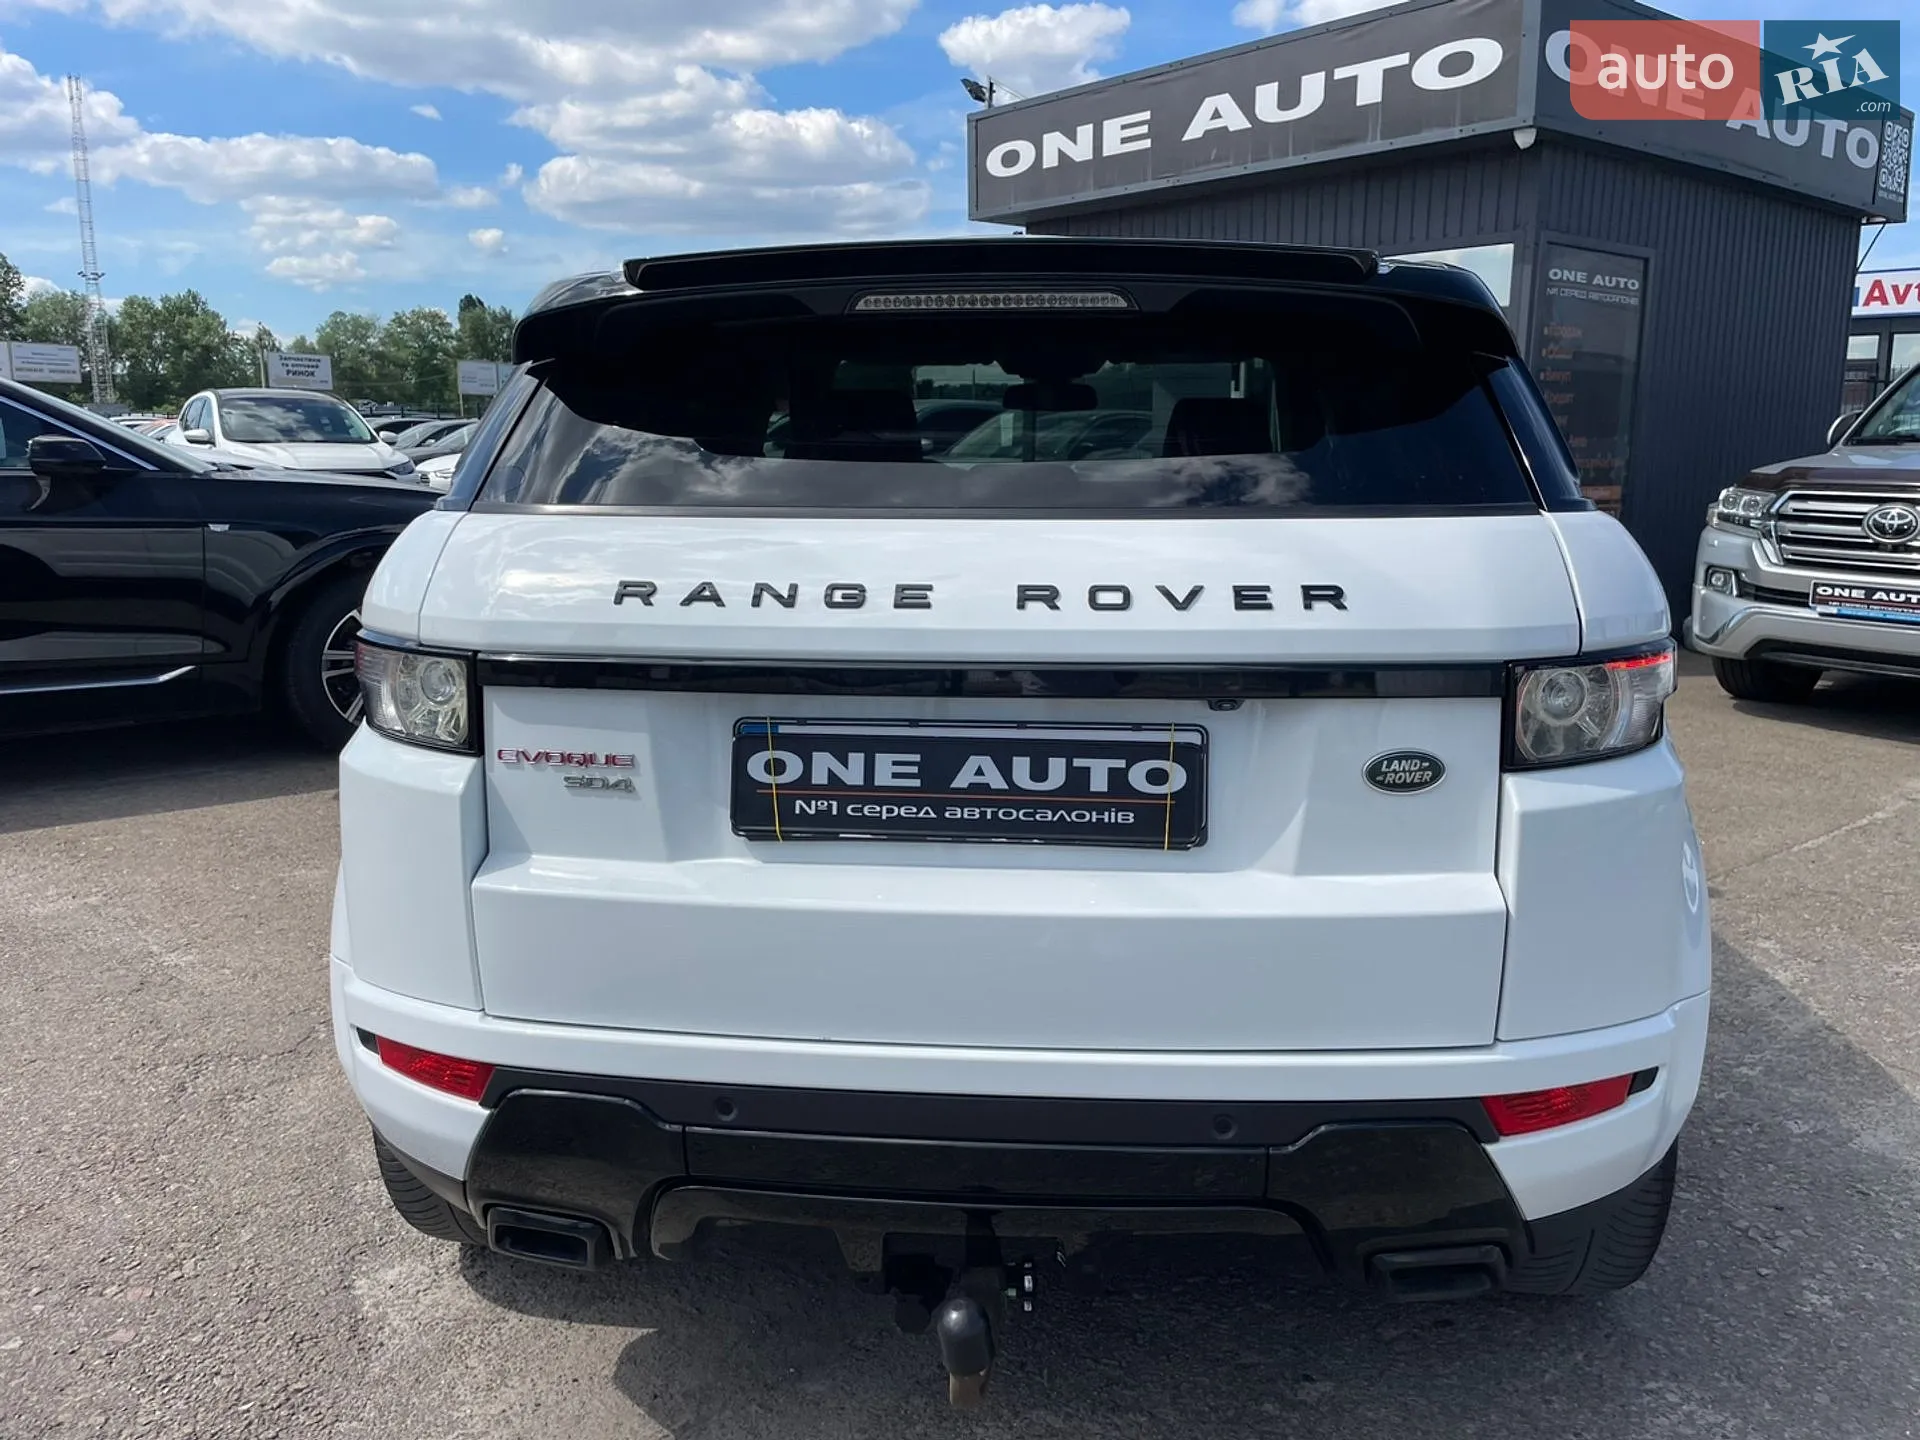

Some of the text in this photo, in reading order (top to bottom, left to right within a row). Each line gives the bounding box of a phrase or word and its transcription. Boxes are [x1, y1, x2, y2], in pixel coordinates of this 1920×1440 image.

[985, 37, 1503, 178] ONE AUTO
[1545, 30, 1879, 169] ONE AUTO
[1548, 268, 1640, 290] ONE AUTO
[612, 579, 1349, 611] RANGE ROVER
[1816, 586, 1866, 599] ONE
[497, 749, 635, 768] EVOQUE
[564, 775, 636, 794] SD4
[746, 750, 1189, 795] ONE AUTO
[793, 799, 1135, 824] №1 серед автосалонів
